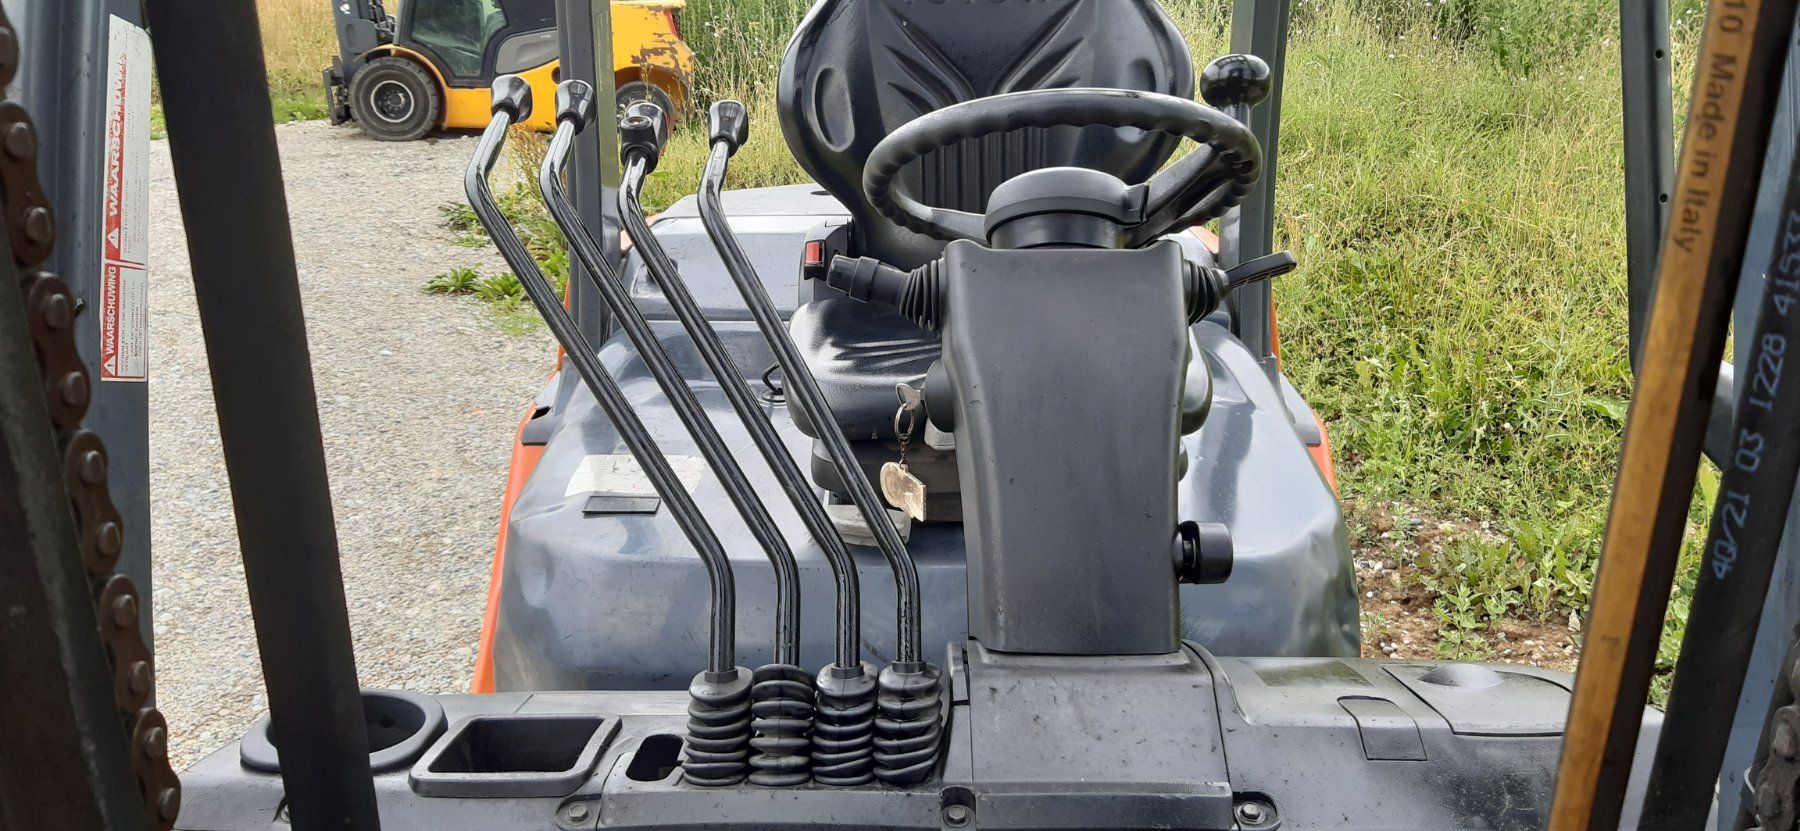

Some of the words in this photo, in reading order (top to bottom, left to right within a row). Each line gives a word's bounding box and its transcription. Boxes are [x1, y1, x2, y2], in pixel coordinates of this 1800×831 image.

[1697, 53, 1738, 141] Made
[1690, 150, 1718, 179] in
[1673, 188, 1711, 254] Italy
[105, 266, 116, 355] WAARSCHUWING
[1749, 333, 1787, 412] 1228
